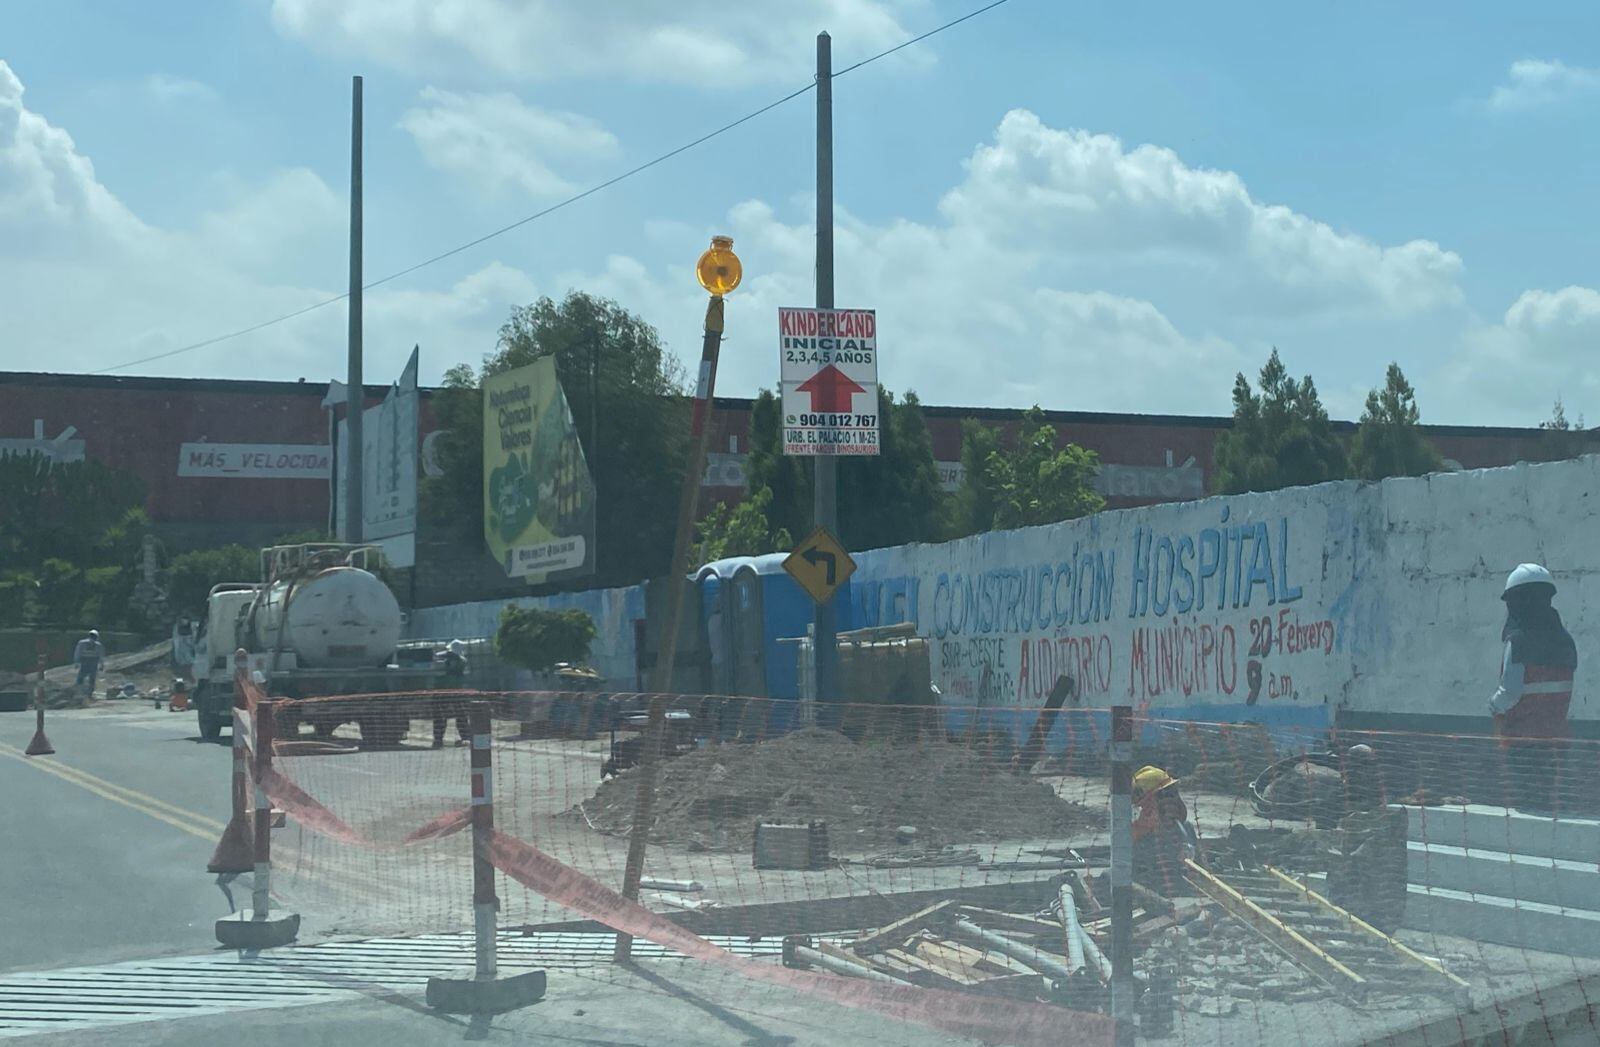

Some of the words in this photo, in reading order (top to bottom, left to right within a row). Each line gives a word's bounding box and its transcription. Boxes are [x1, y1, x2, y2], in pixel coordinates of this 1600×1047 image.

[780, 311, 874, 338] KINDERLAND
[784, 338, 873, 351] INICIAL
[786, 351, 831, 365] 2,3,4,5
[835, 350, 872, 364] AÑOS
[800, 414, 826, 427] 904
[829, 415, 852, 427] 012
[855, 415, 877, 428] 767
[787, 431, 806, 444] URB.
[808, 431, 817, 444] EL
[819, 431, 851, 444] PALACIO
[859, 432, 877, 444] M-25
[188, 448, 329, 473] MÁS_VELOCIDA
[1128, 506, 1304, 618] HOSPITAL
[1127, 616, 1238, 696] MUNICIPIO
